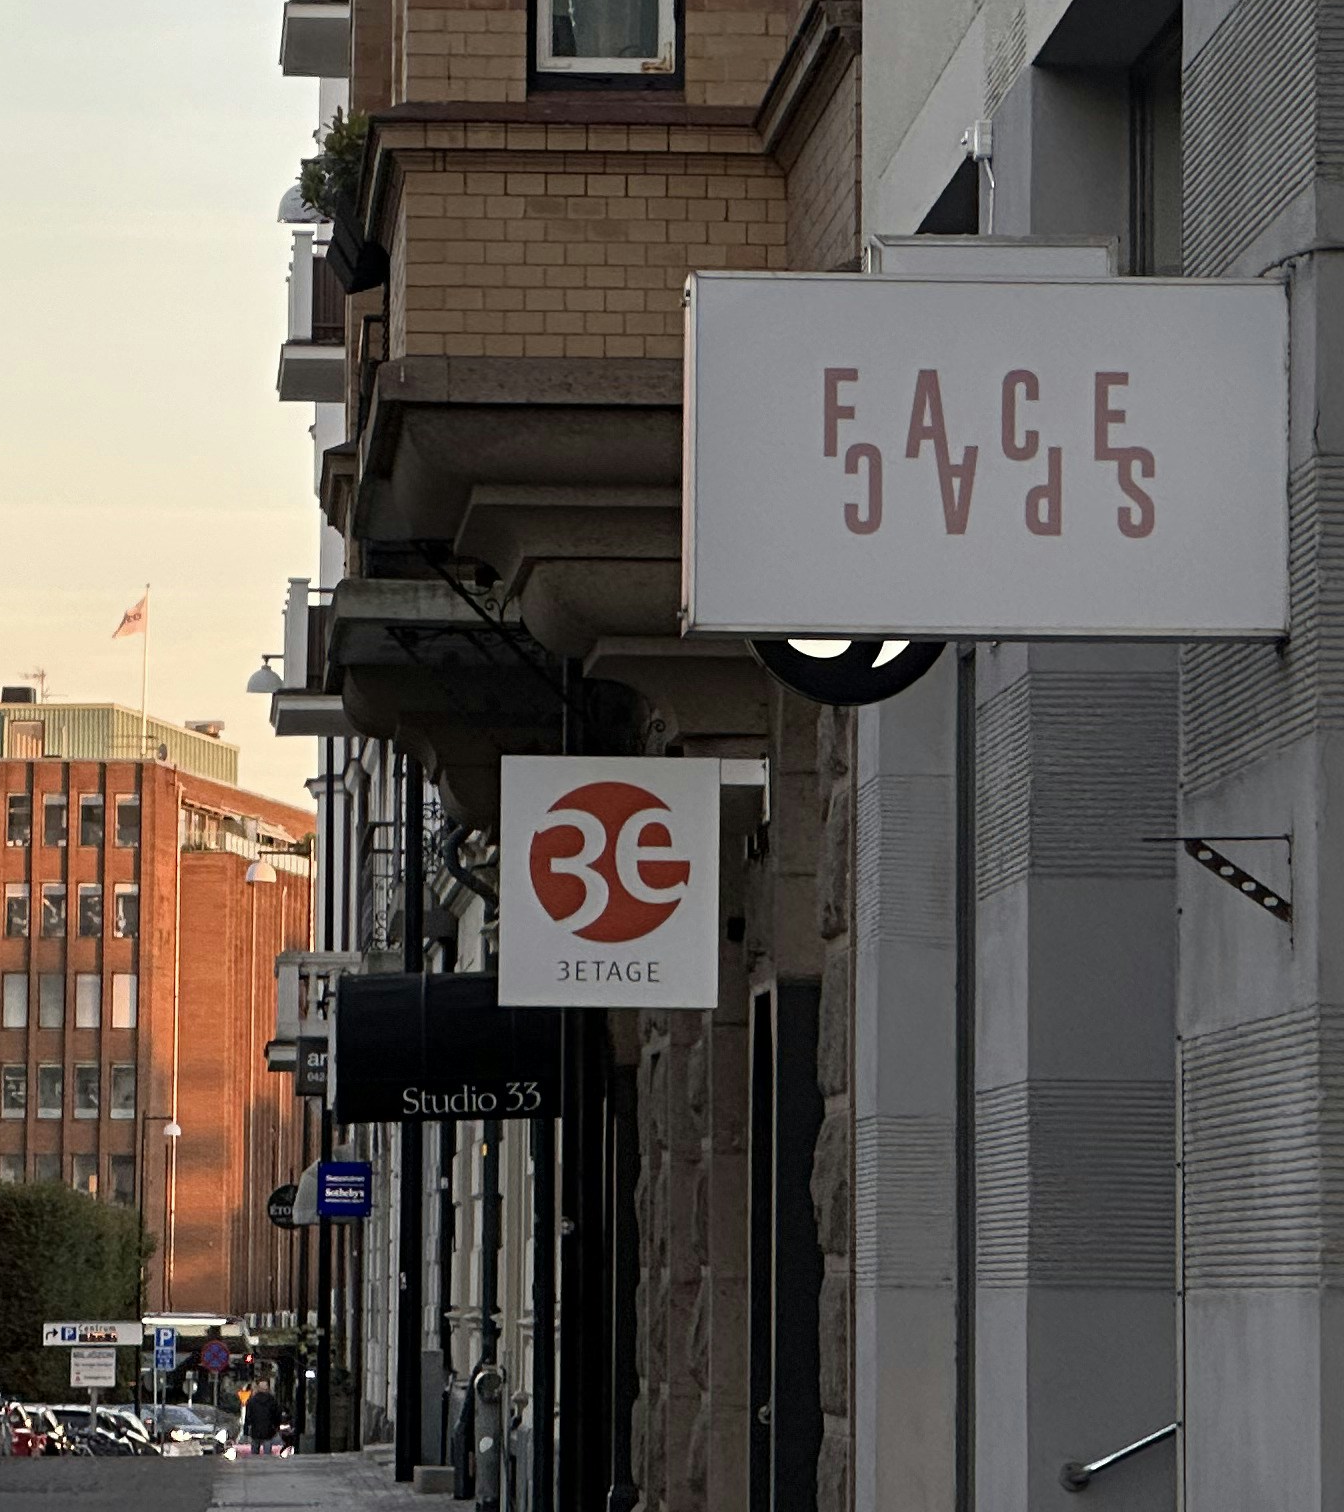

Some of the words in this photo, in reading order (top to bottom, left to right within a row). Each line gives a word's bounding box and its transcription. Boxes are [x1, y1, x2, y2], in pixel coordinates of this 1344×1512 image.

[823, 366, 1131, 462] FACE
[556, 959, 661, 984] 3ETAGE
[402, 1085, 498, 1115] Studio
[505, 1081, 543, 1112] 33
[159, 1329, 173, 1346] P
